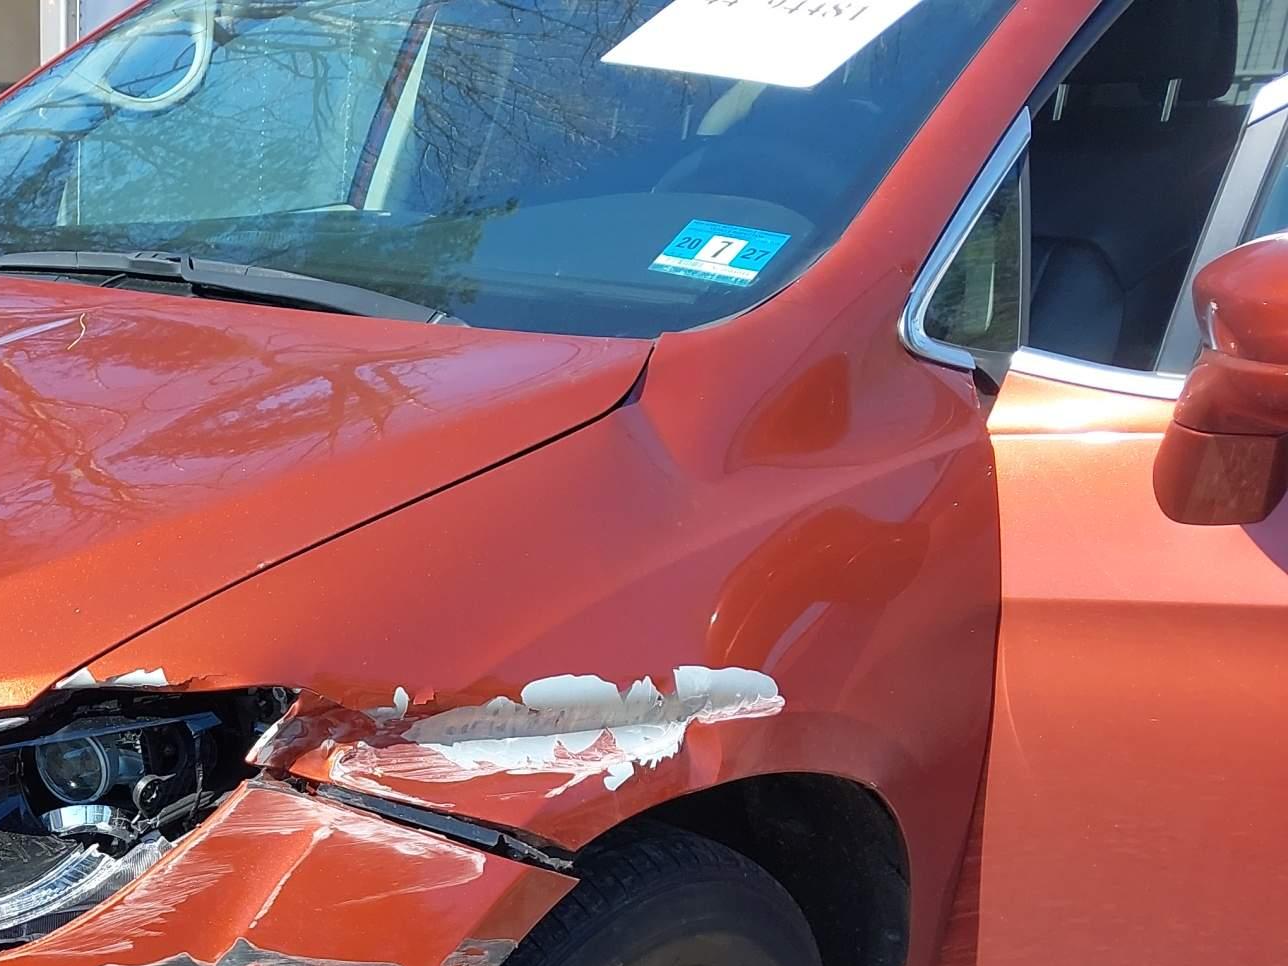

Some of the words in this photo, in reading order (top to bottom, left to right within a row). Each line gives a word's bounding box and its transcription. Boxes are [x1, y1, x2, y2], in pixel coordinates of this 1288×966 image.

[675, 236, 702, 250] 20
[711, 240, 734, 258] 7
[742, 247, 770, 261] 27
